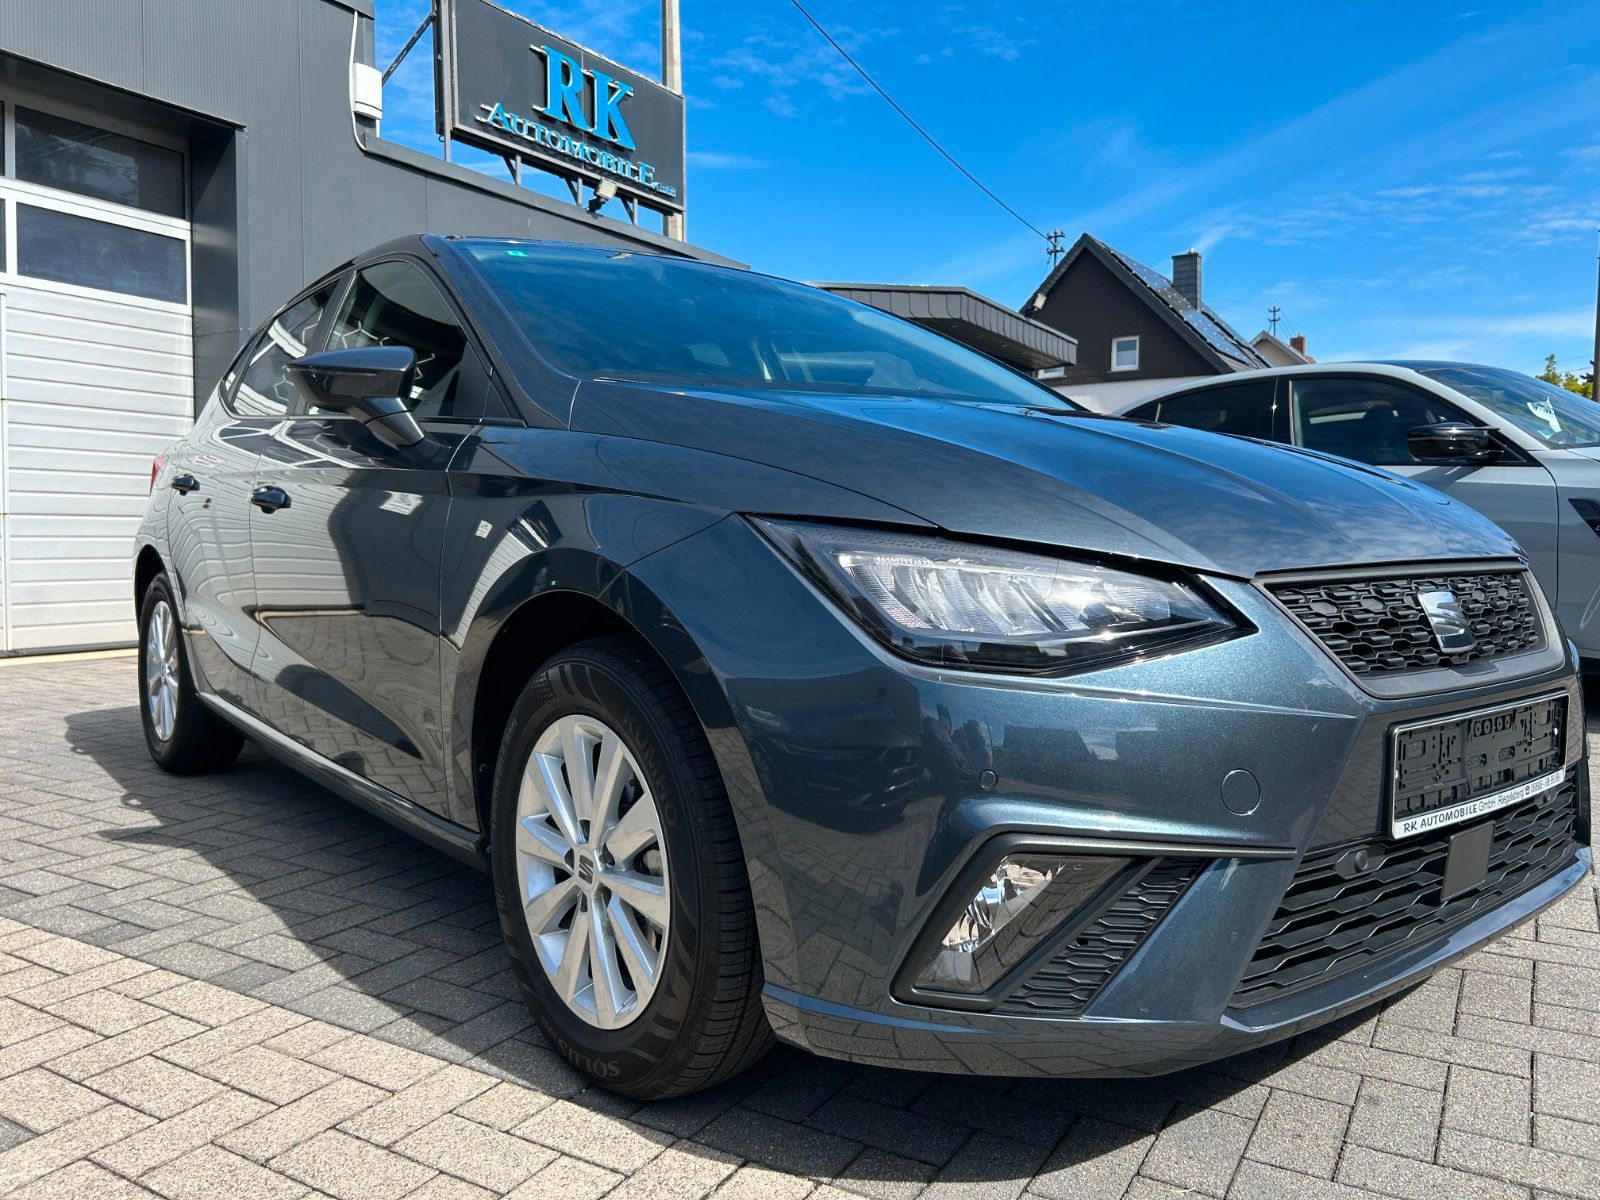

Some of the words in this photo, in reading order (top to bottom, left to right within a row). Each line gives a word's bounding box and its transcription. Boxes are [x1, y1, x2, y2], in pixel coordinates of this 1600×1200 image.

[536, 45, 636, 151] RK
[480, 102, 656, 189] AUTOMOBILE
[1402, 821, 1418, 834] RK
[1420, 804, 1477, 830] AUTOMOBILE
[1478, 798, 1496, 812] GmbH
